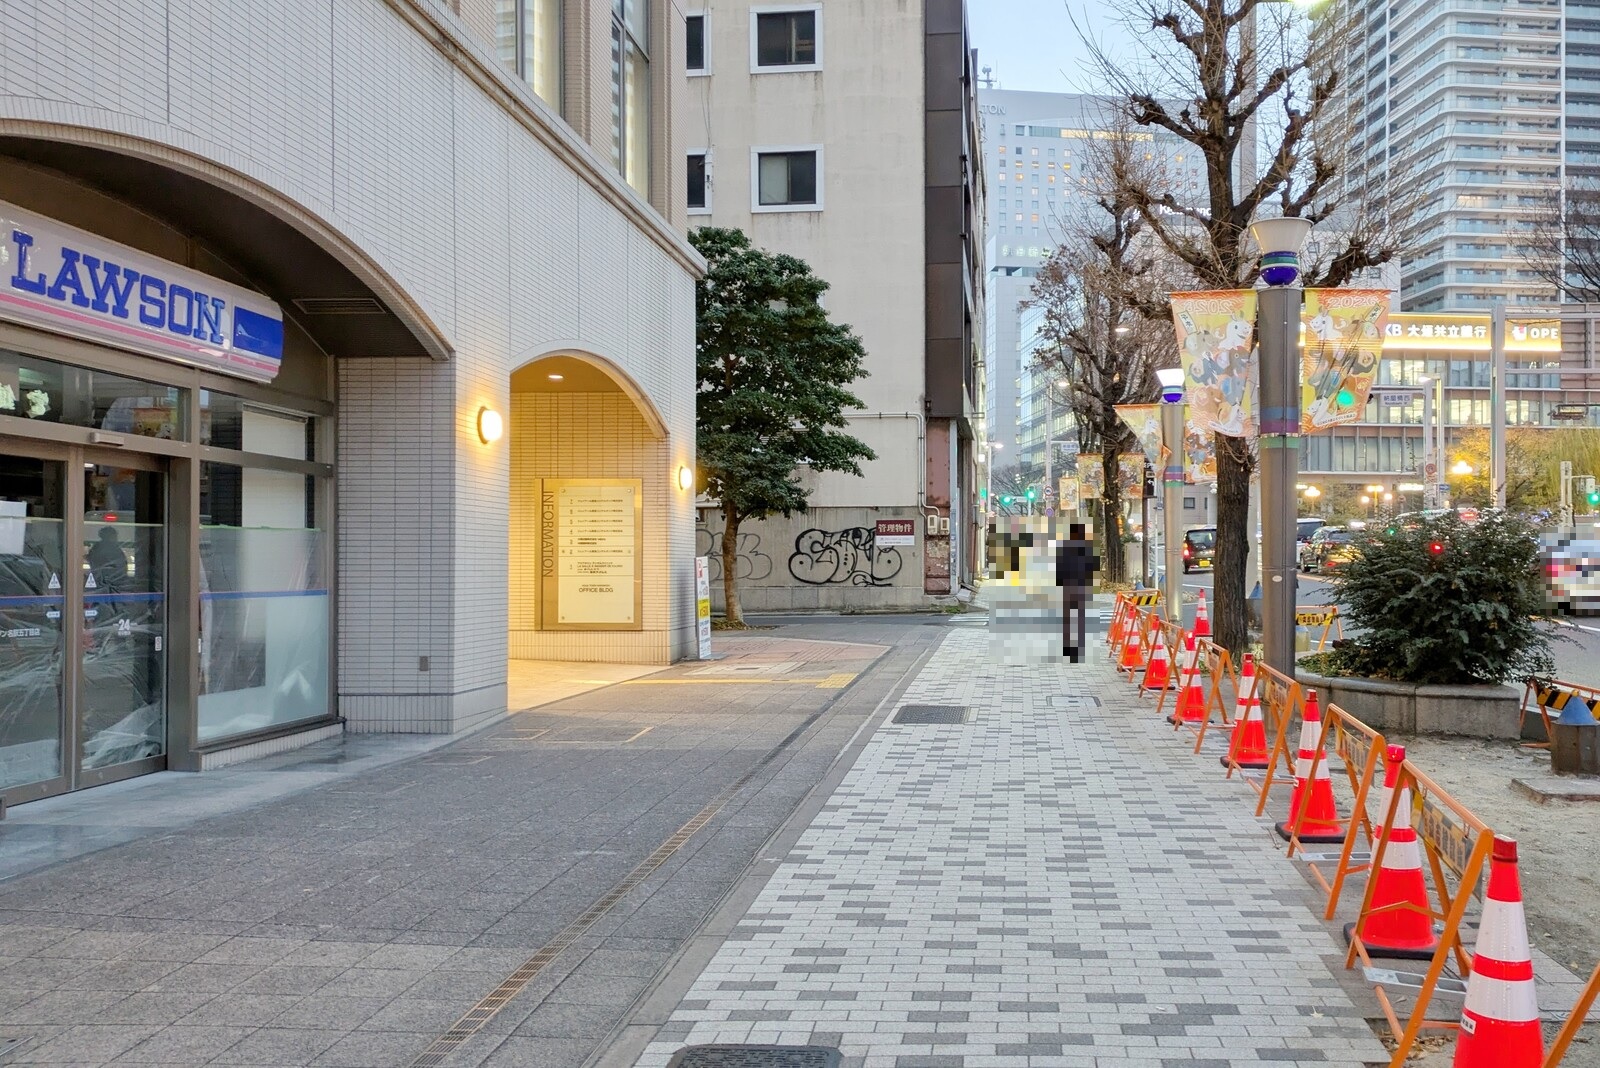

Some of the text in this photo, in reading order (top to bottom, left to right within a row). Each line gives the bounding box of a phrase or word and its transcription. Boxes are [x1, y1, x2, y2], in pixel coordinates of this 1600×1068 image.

[981, 103, 1006, 115] TON
[11, 229, 226, 345] LAWSON
[1328, 295, 1378, 310] 2026
[1407, 324, 1487, 339] 大垣共立銀行
[542, 491, 554, 578] INFORMATION
[878, 523, 912, 533] 管理物件
[118, 619, 131, 631] 24
